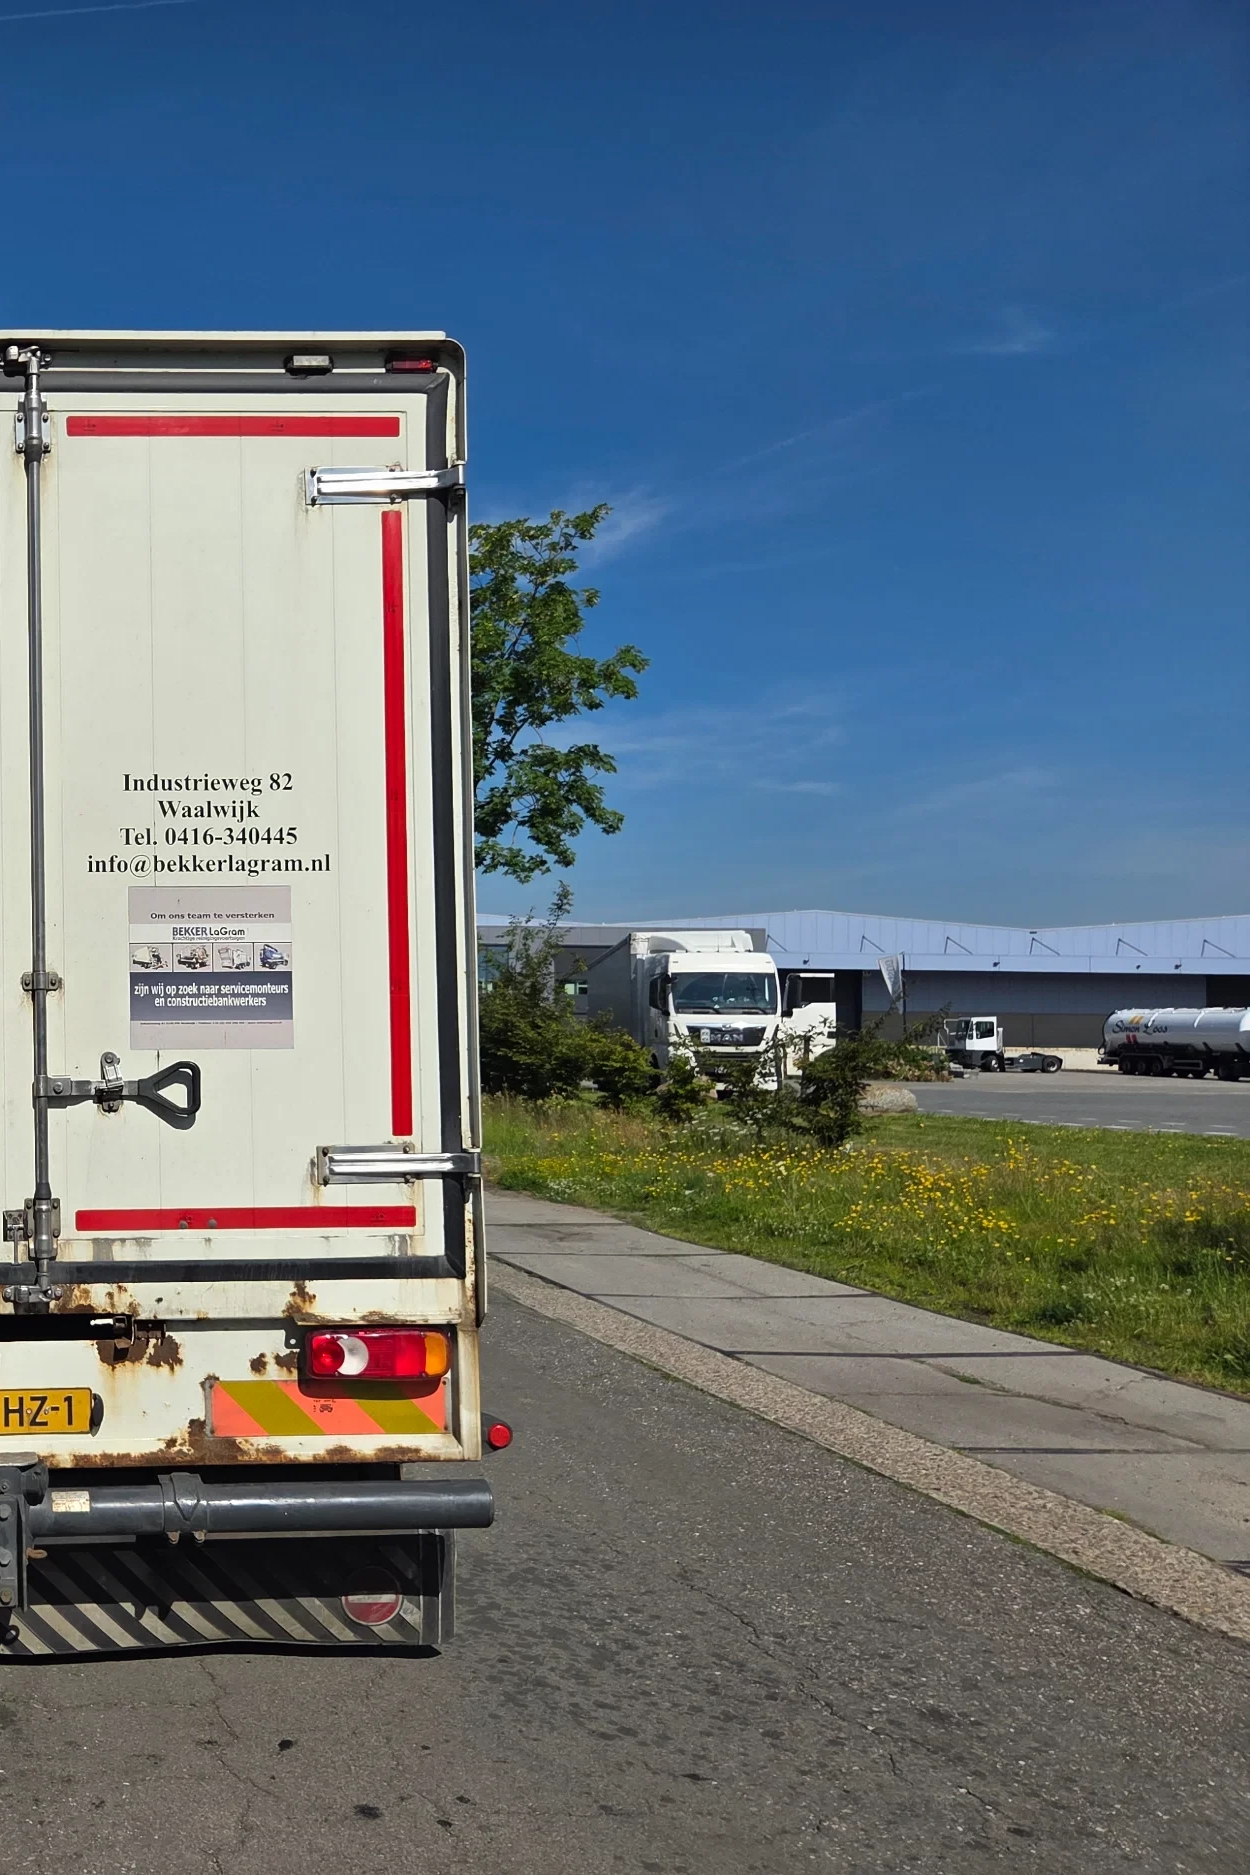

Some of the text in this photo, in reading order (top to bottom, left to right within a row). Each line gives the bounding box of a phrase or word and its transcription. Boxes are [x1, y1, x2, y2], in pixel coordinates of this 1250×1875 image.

[122, 772, 294, 796] Industrieweg 82
[157, 800, 260, 823] Waalwijk
[120, 826, 298, 846] Tel. 0416-340445
[87, 854, 331, 878] info@bekkerlagram.nl
[150, 912, 166, 920] Om
[225, 911, 275, 919] versterken
[134, 982, 289, 997] zijn wij op zoek naar servicemonteurs
[154, 995, 267, 1007] en constructiebankwerkers
